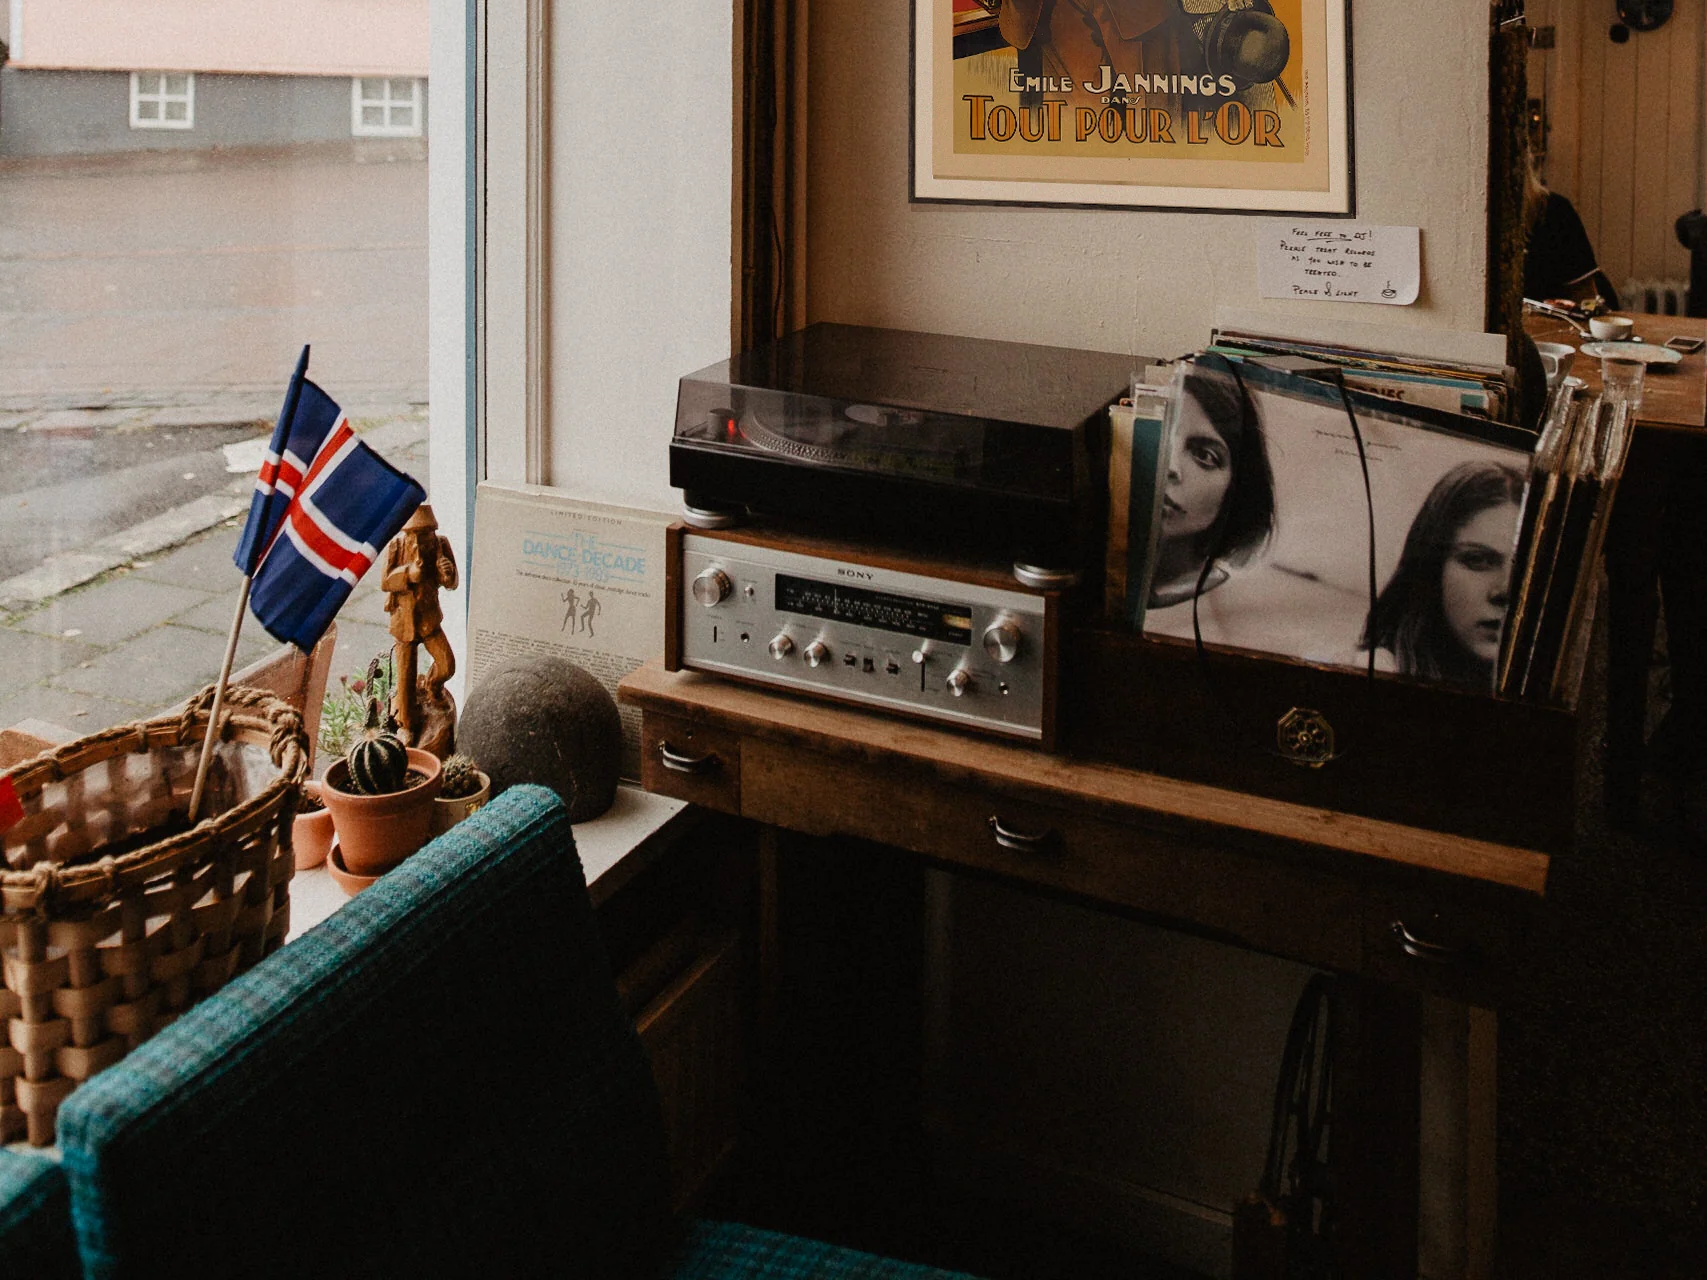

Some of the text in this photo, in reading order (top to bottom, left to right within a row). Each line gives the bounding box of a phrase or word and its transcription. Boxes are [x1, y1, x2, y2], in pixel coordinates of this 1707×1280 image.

[1009, 64, 1237, 97] EMILE JANNINGS
[962, 95, 1068, 142] TOUT
[1075, 106, 1176, 144] POUR
[1187, 101, 1285, 148] L'OR
[587, 514, 623, 526] EDITION
[522, 538, 646, 575] DANCE DECADE
[838, 568, 874, 581] SONY
